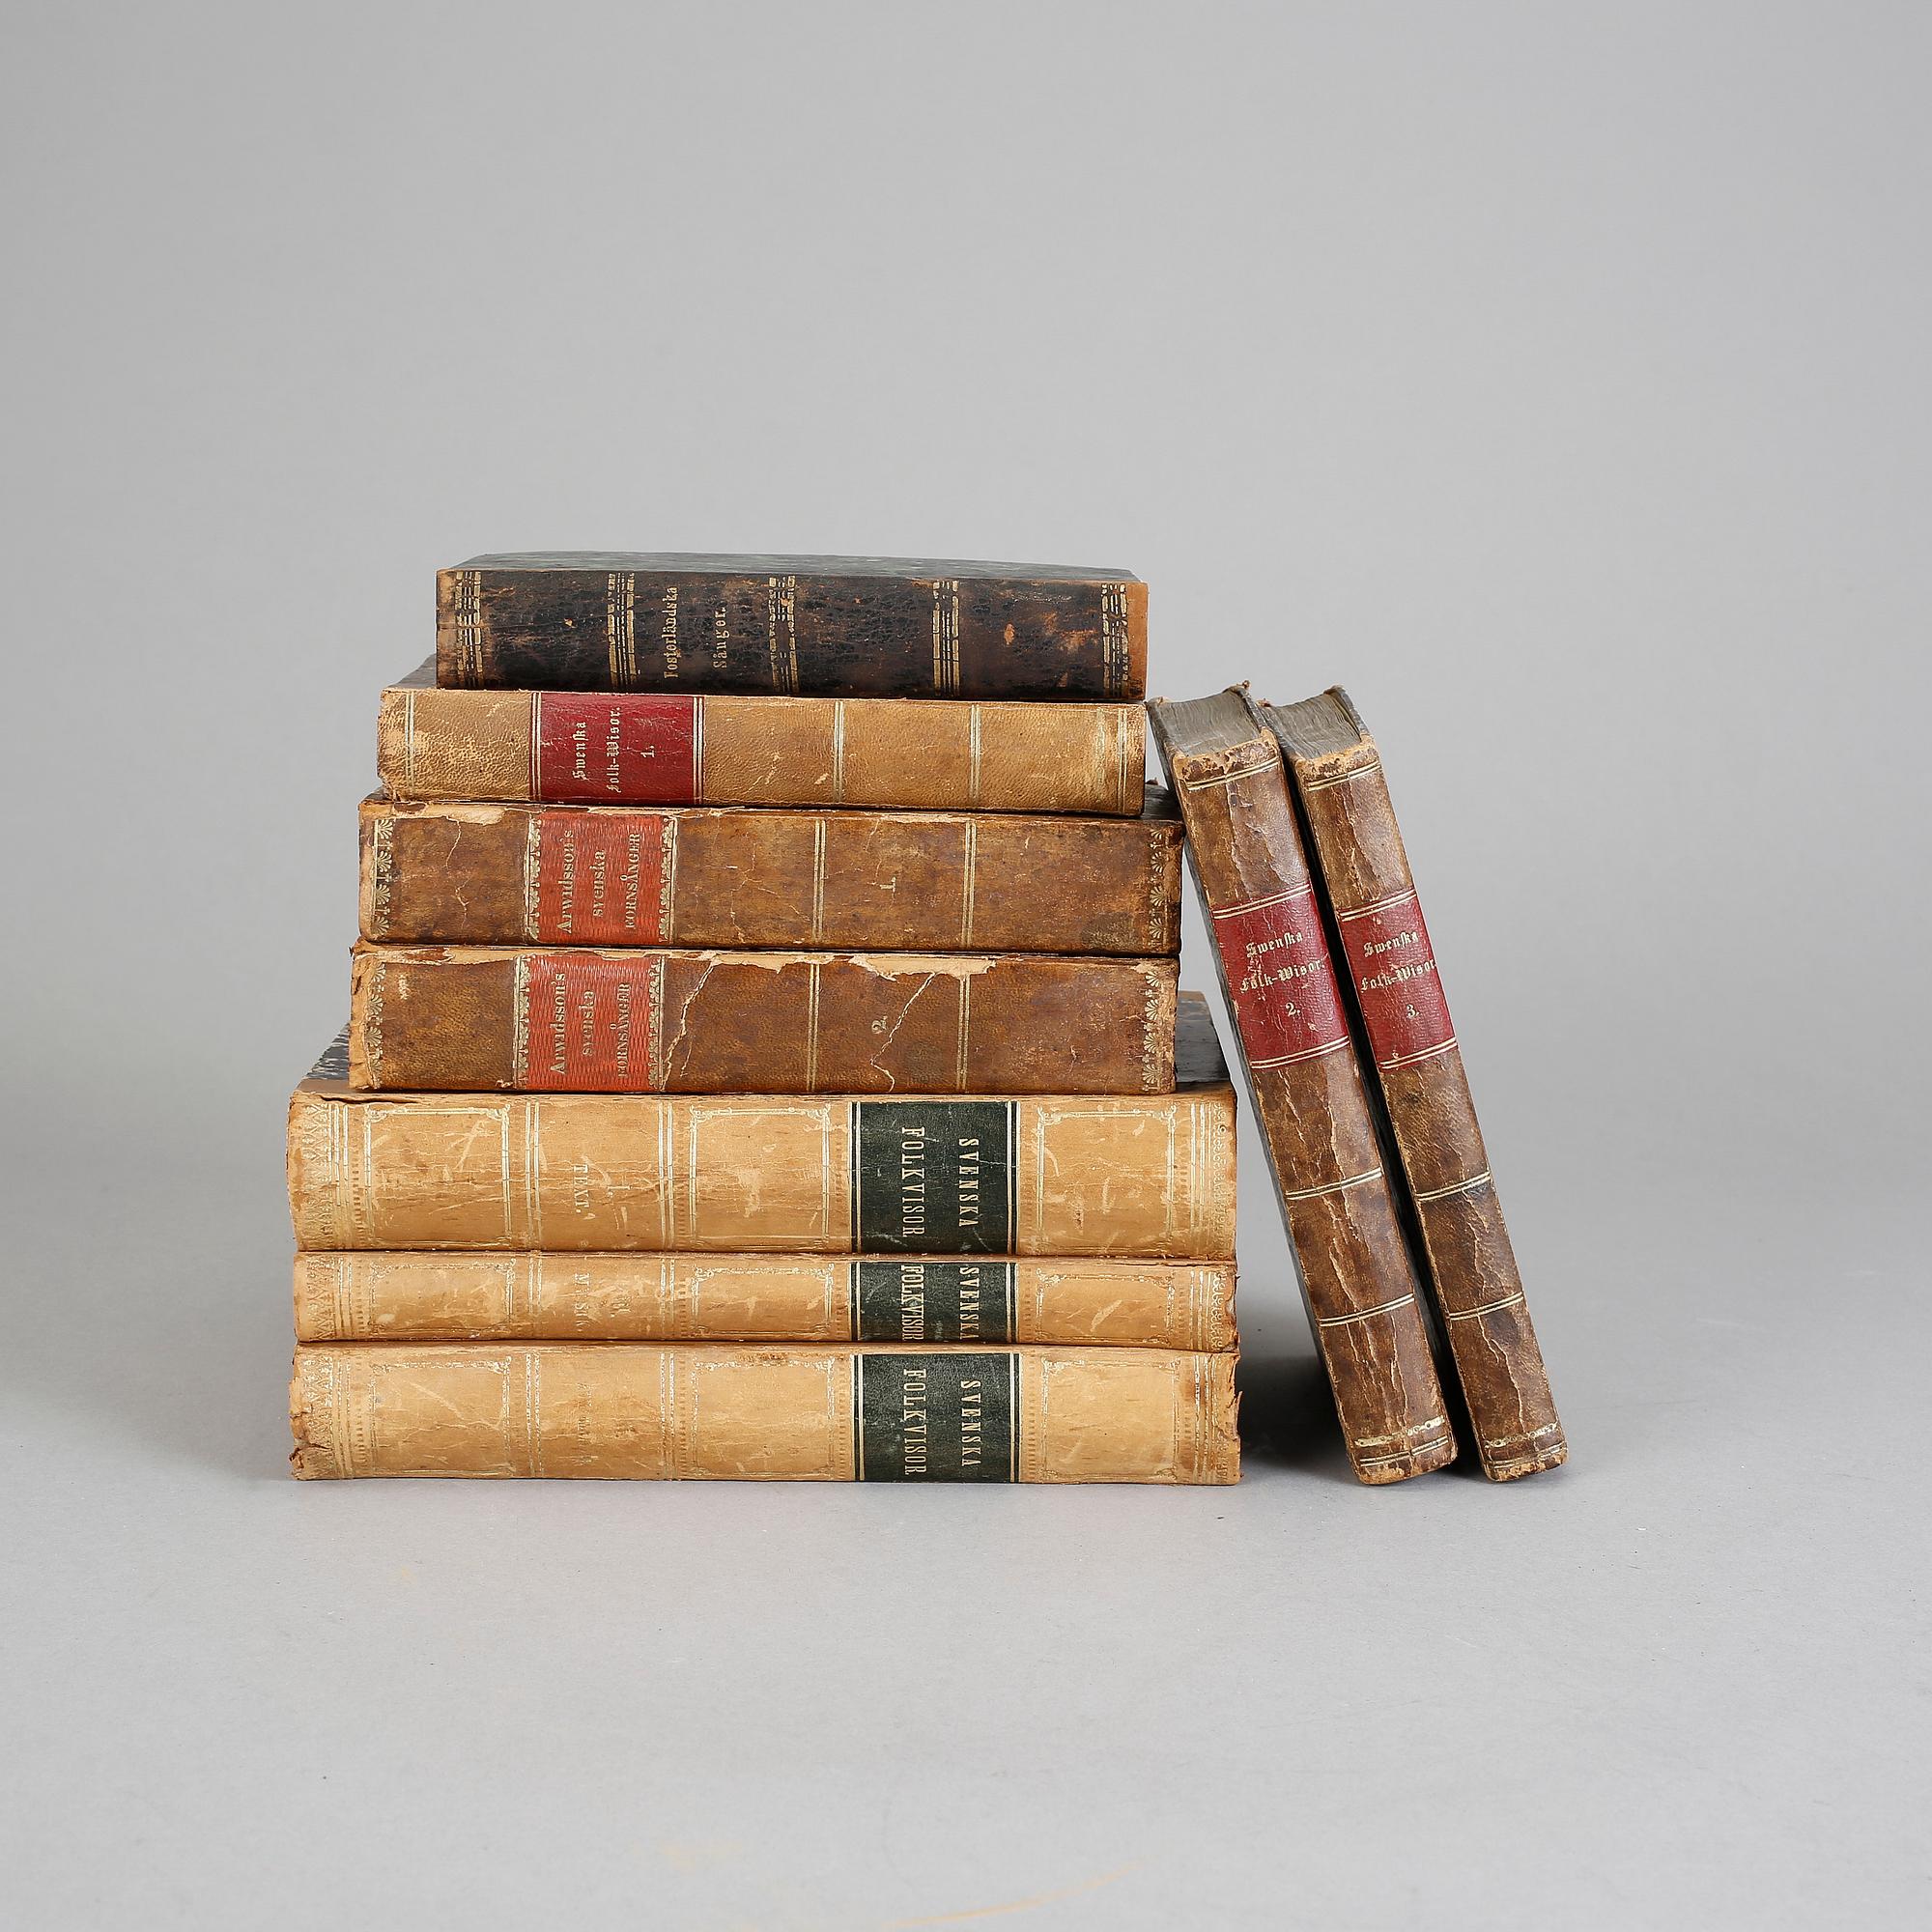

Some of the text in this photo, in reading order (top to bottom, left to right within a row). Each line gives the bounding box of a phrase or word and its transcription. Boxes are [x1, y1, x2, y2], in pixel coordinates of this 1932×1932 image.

[640, 745, 655, 758] 1.
[556, 830, 574, 933] Arwidsson's
[589, 850, 605, 917] svenska
[549, 973, 566, 1074] Arwidsson's
[1286, 1002, 1300, 1016] 2.
[573, 1164, 589, 1213] TEXT.
[901, 1126, 924, 1237] FOLKVISOR
[959, 1138, 980, 1227] SVENSKA
[901, 1264, 924, 1341] FOLKVISOR
[959, 1267, 980, 1340] SVENSKA
[903, 1369, 926, 1475] FOLKVISOR
[961, 1380, 981, 1466] SVENSKA
